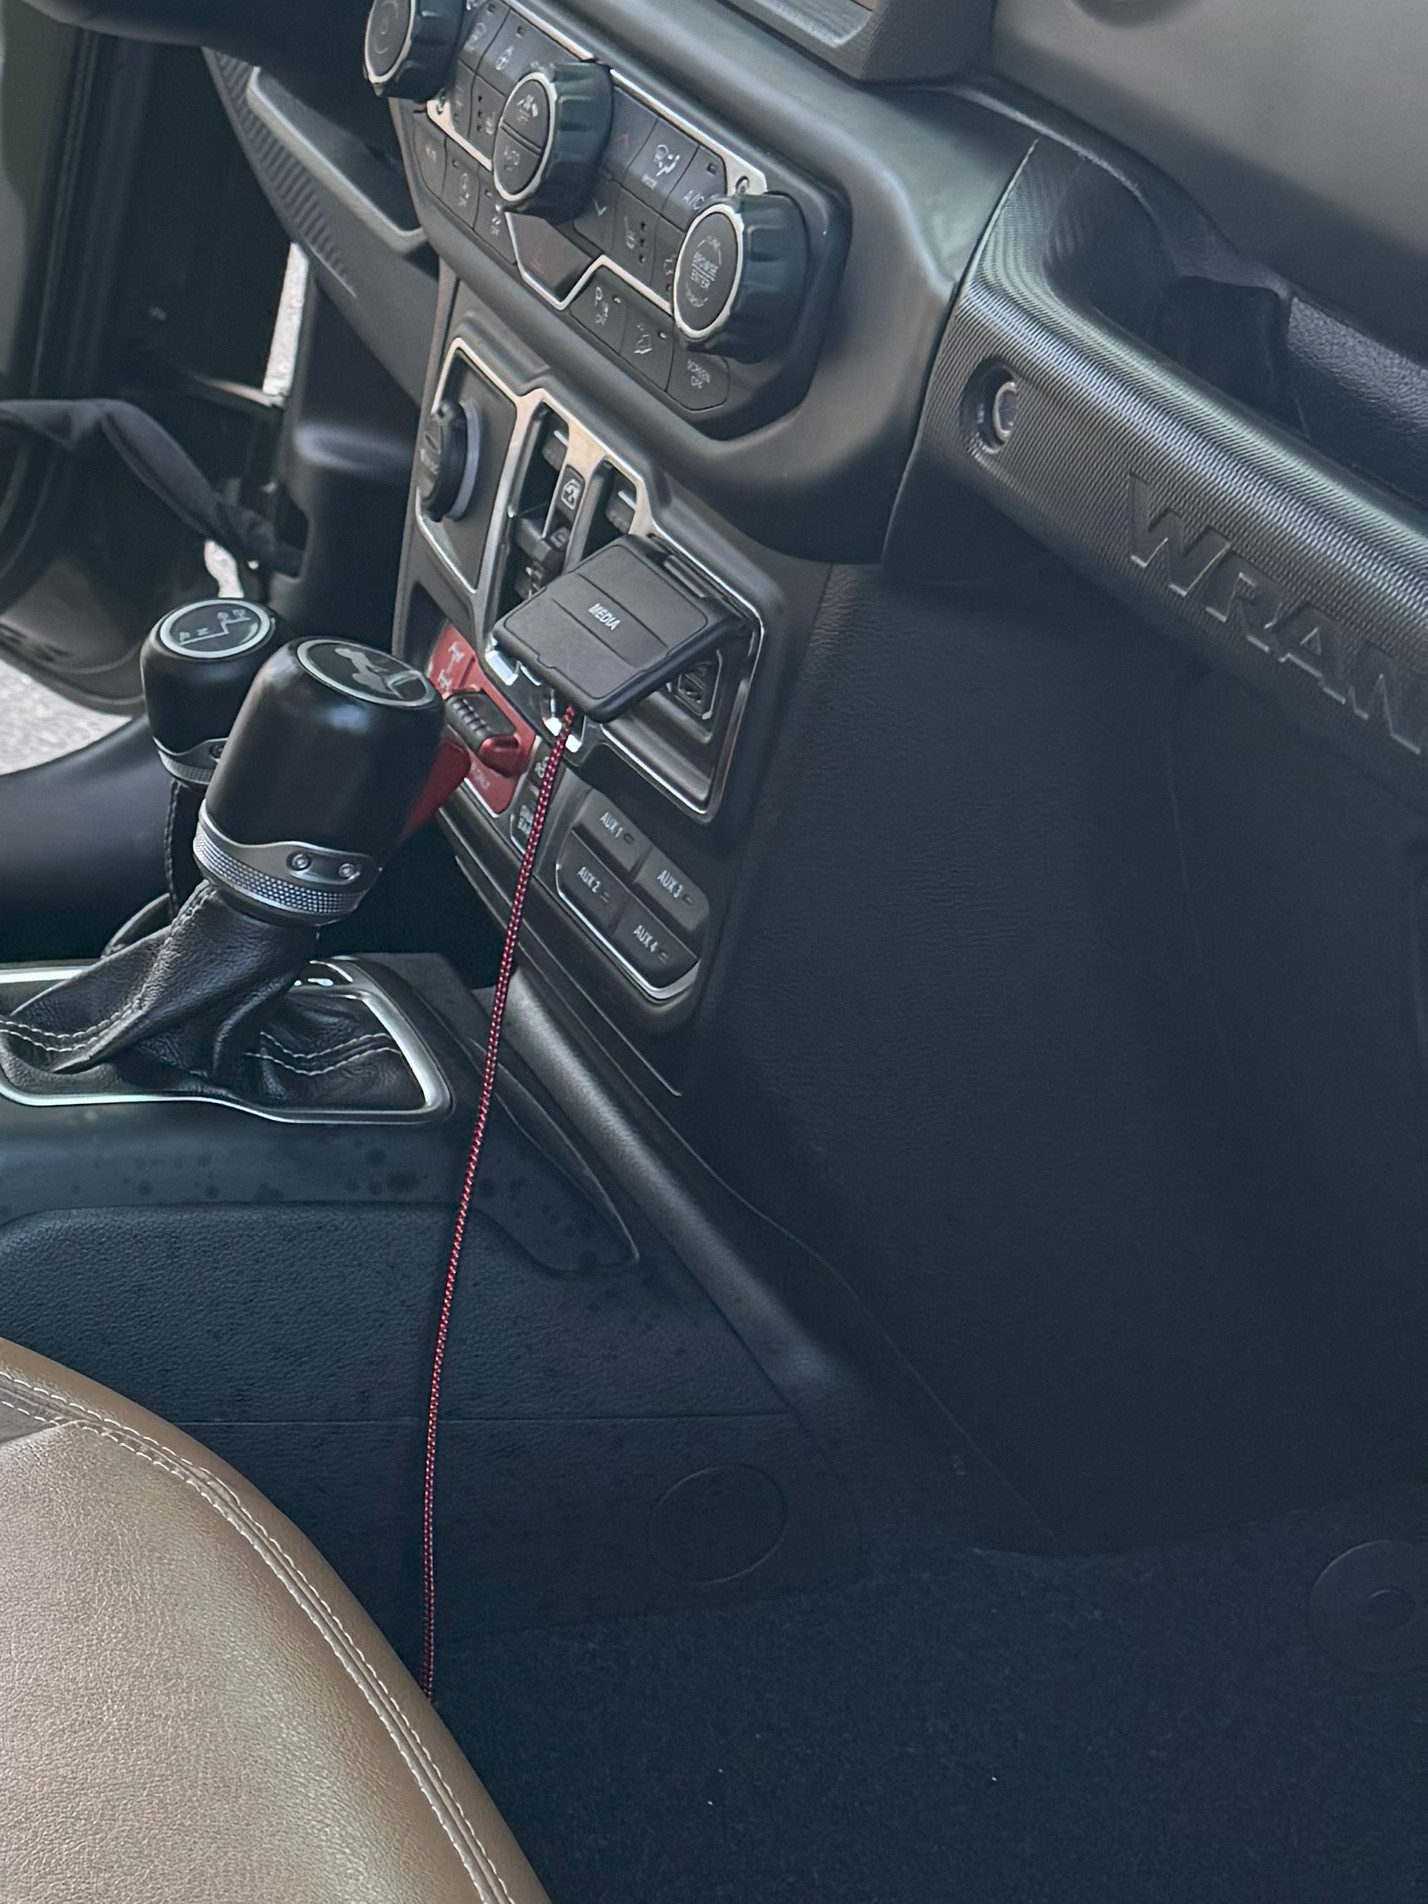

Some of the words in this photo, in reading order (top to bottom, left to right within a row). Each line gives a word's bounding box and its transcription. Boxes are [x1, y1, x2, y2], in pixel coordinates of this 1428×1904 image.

[588, 602, 621, 631] MEDIA
[599, 811, 619, 834] AUX
[614, 826, 624, 838] 1
[577, 866, 598, 888] AUX
[591, 880, 601, 894] 2
[656, 869, 678, 893] AUX
[673, 883, 684, 898] 3
[633, 924, 654, 948] AUX
[649, 940, 659, 953] 4
